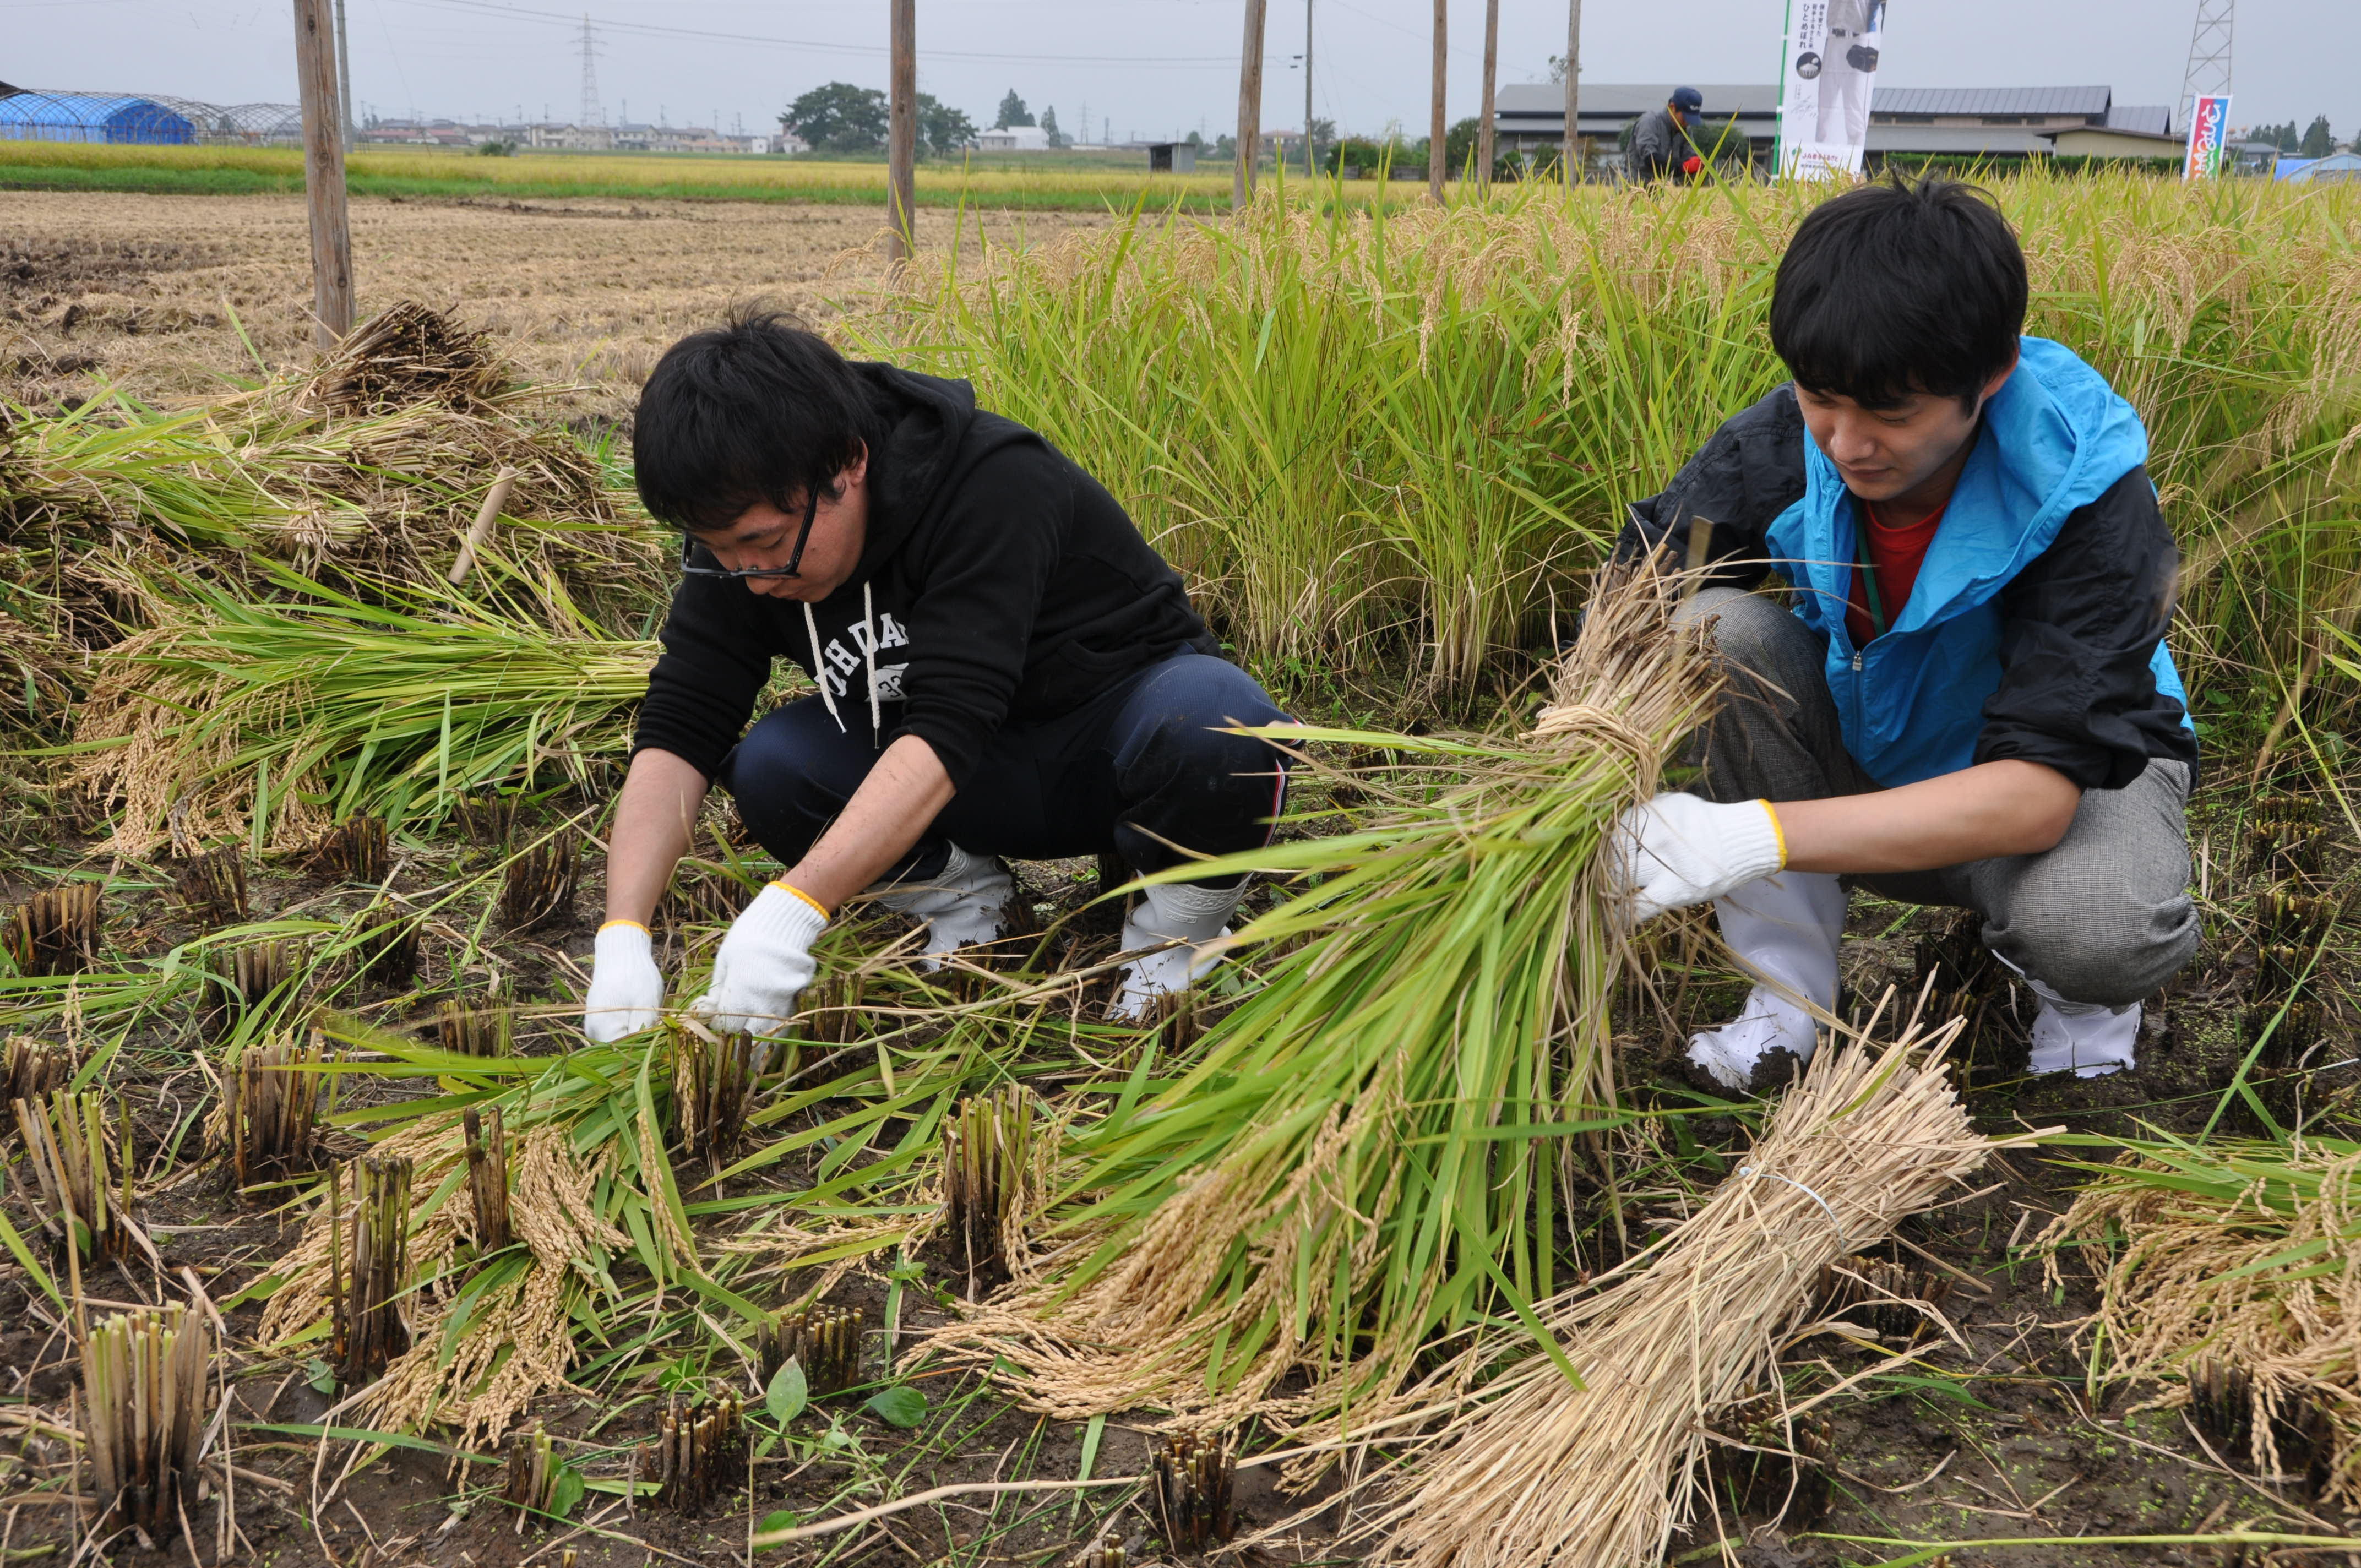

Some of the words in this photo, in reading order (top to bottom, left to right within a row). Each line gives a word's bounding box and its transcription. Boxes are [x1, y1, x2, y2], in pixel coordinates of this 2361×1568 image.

[1799, 4, 1809, 49] ひとめぼれ
